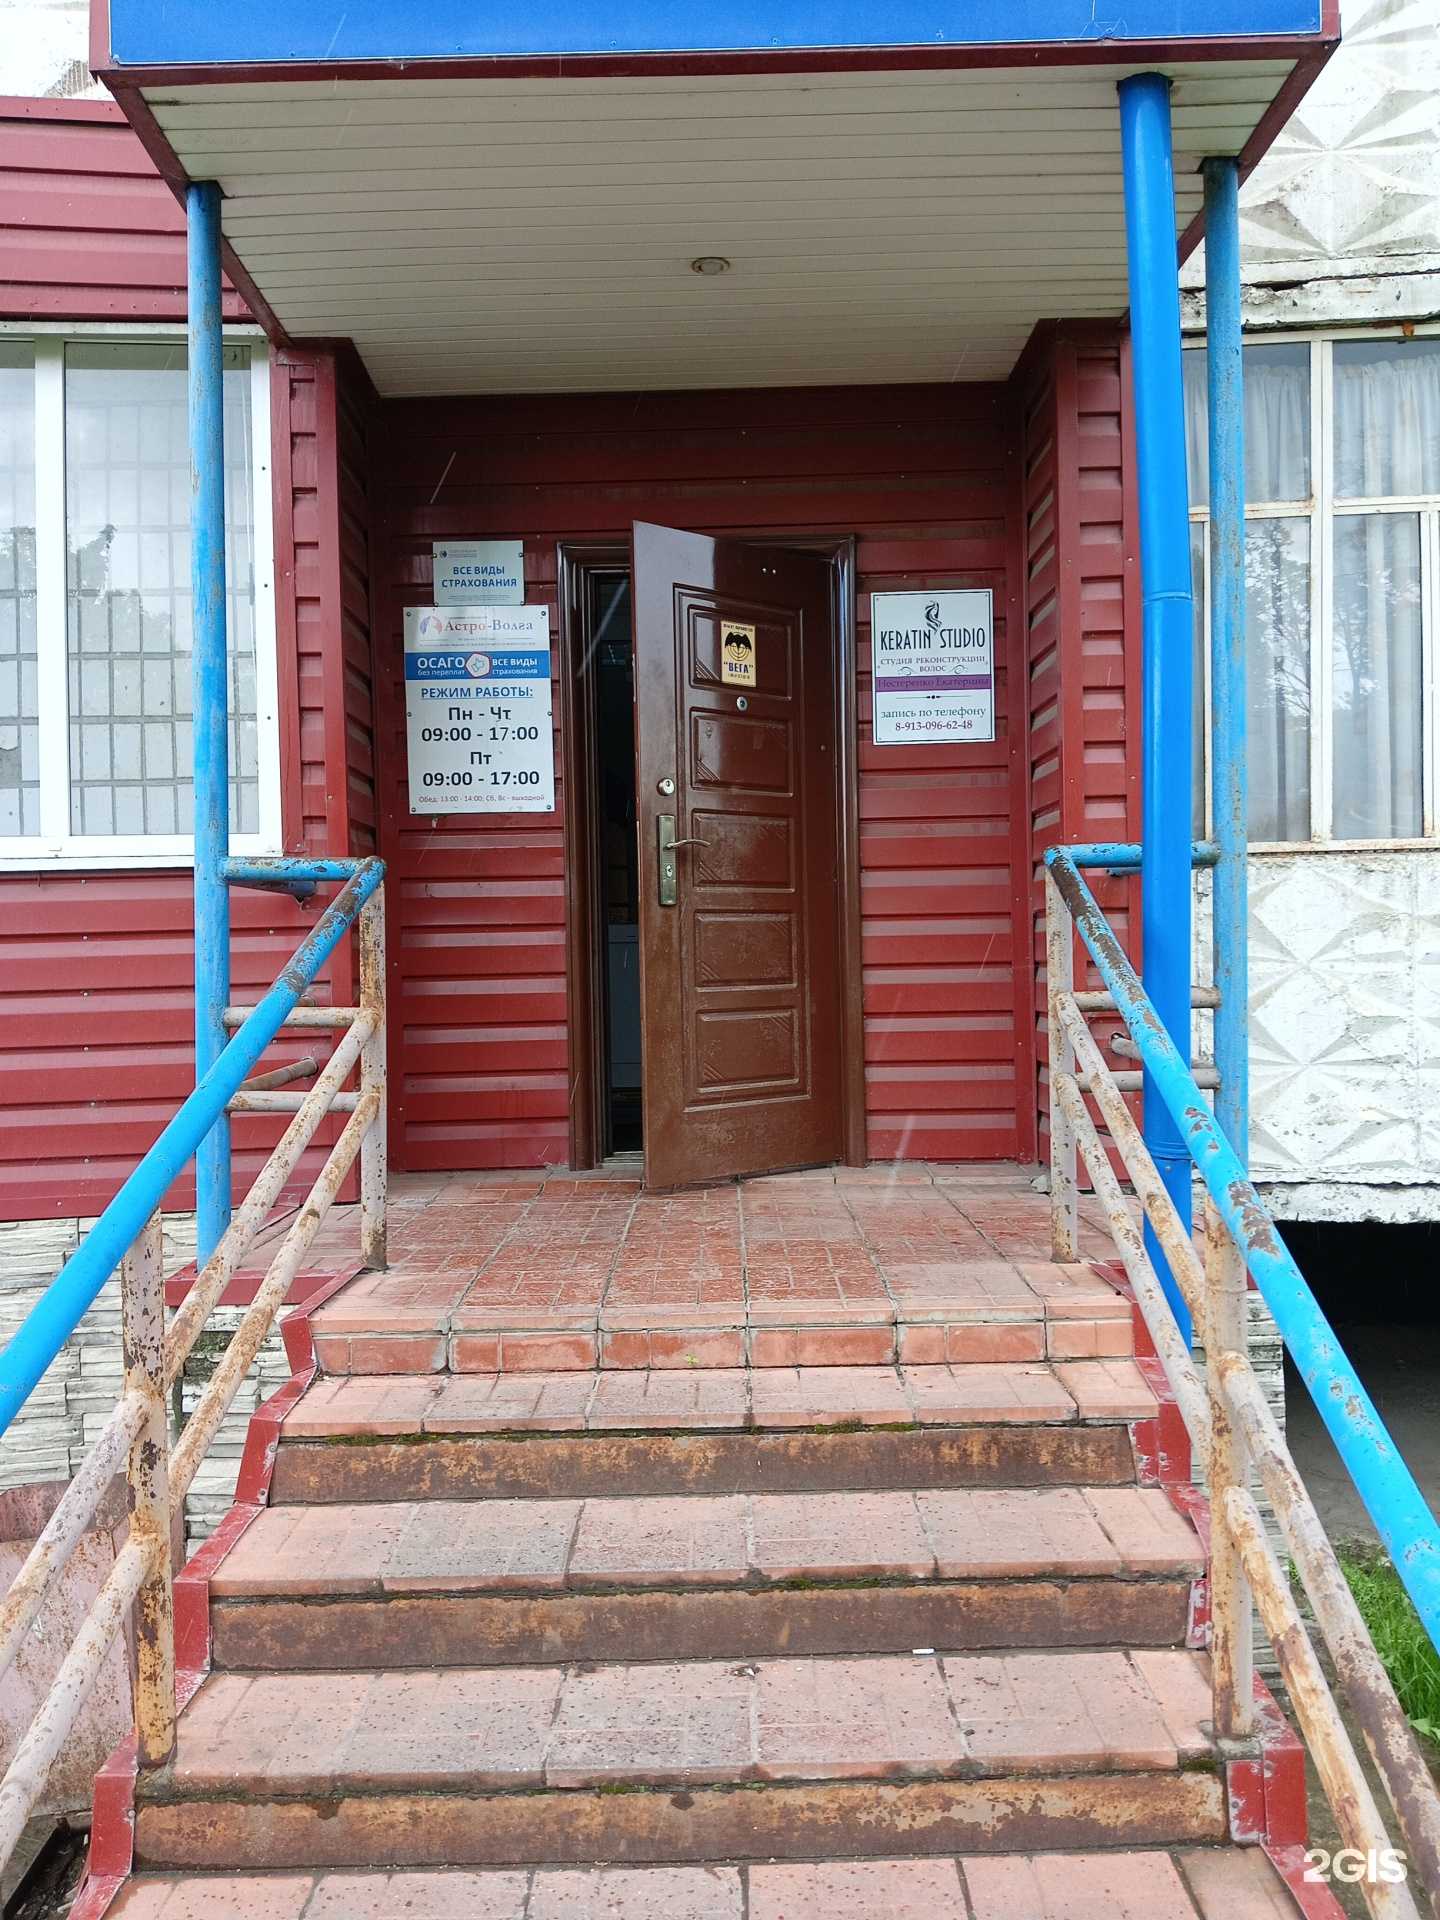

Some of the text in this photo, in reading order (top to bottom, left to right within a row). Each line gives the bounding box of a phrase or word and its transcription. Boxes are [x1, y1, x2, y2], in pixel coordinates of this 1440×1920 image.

[453, 566, 505, 576] ВСЕ ВИДЫ
[442, 579, 517, 588] СТРАХОВАНИЯ
[444, 619, 533, 635] Астро-Волга
[880, 628, 986, 650] KERATIN STUDIO
[417, 657, 465, 669] ОСАГО
[511, 659, 537, 667] ВИДЫ
[492, 668, 538, 676] страхования
[421, 686, 533, 698] РЕЖИМ РАБОТЫ:
[448, 707, 473, 721] Пн
[490, 706, 511, 721] Чт
[881, 706, 986, 718] запись по телефону
[895, 720, 973, 731] 8-913-096-62-48
[421, 727, 472, 742] 09:00
[489, 726, 539, 741] 17:00
[470, 751, 492, 765] Пт
[422, 772, 473, 787] 09:00
[490, 771, 540, 786] 17:00
